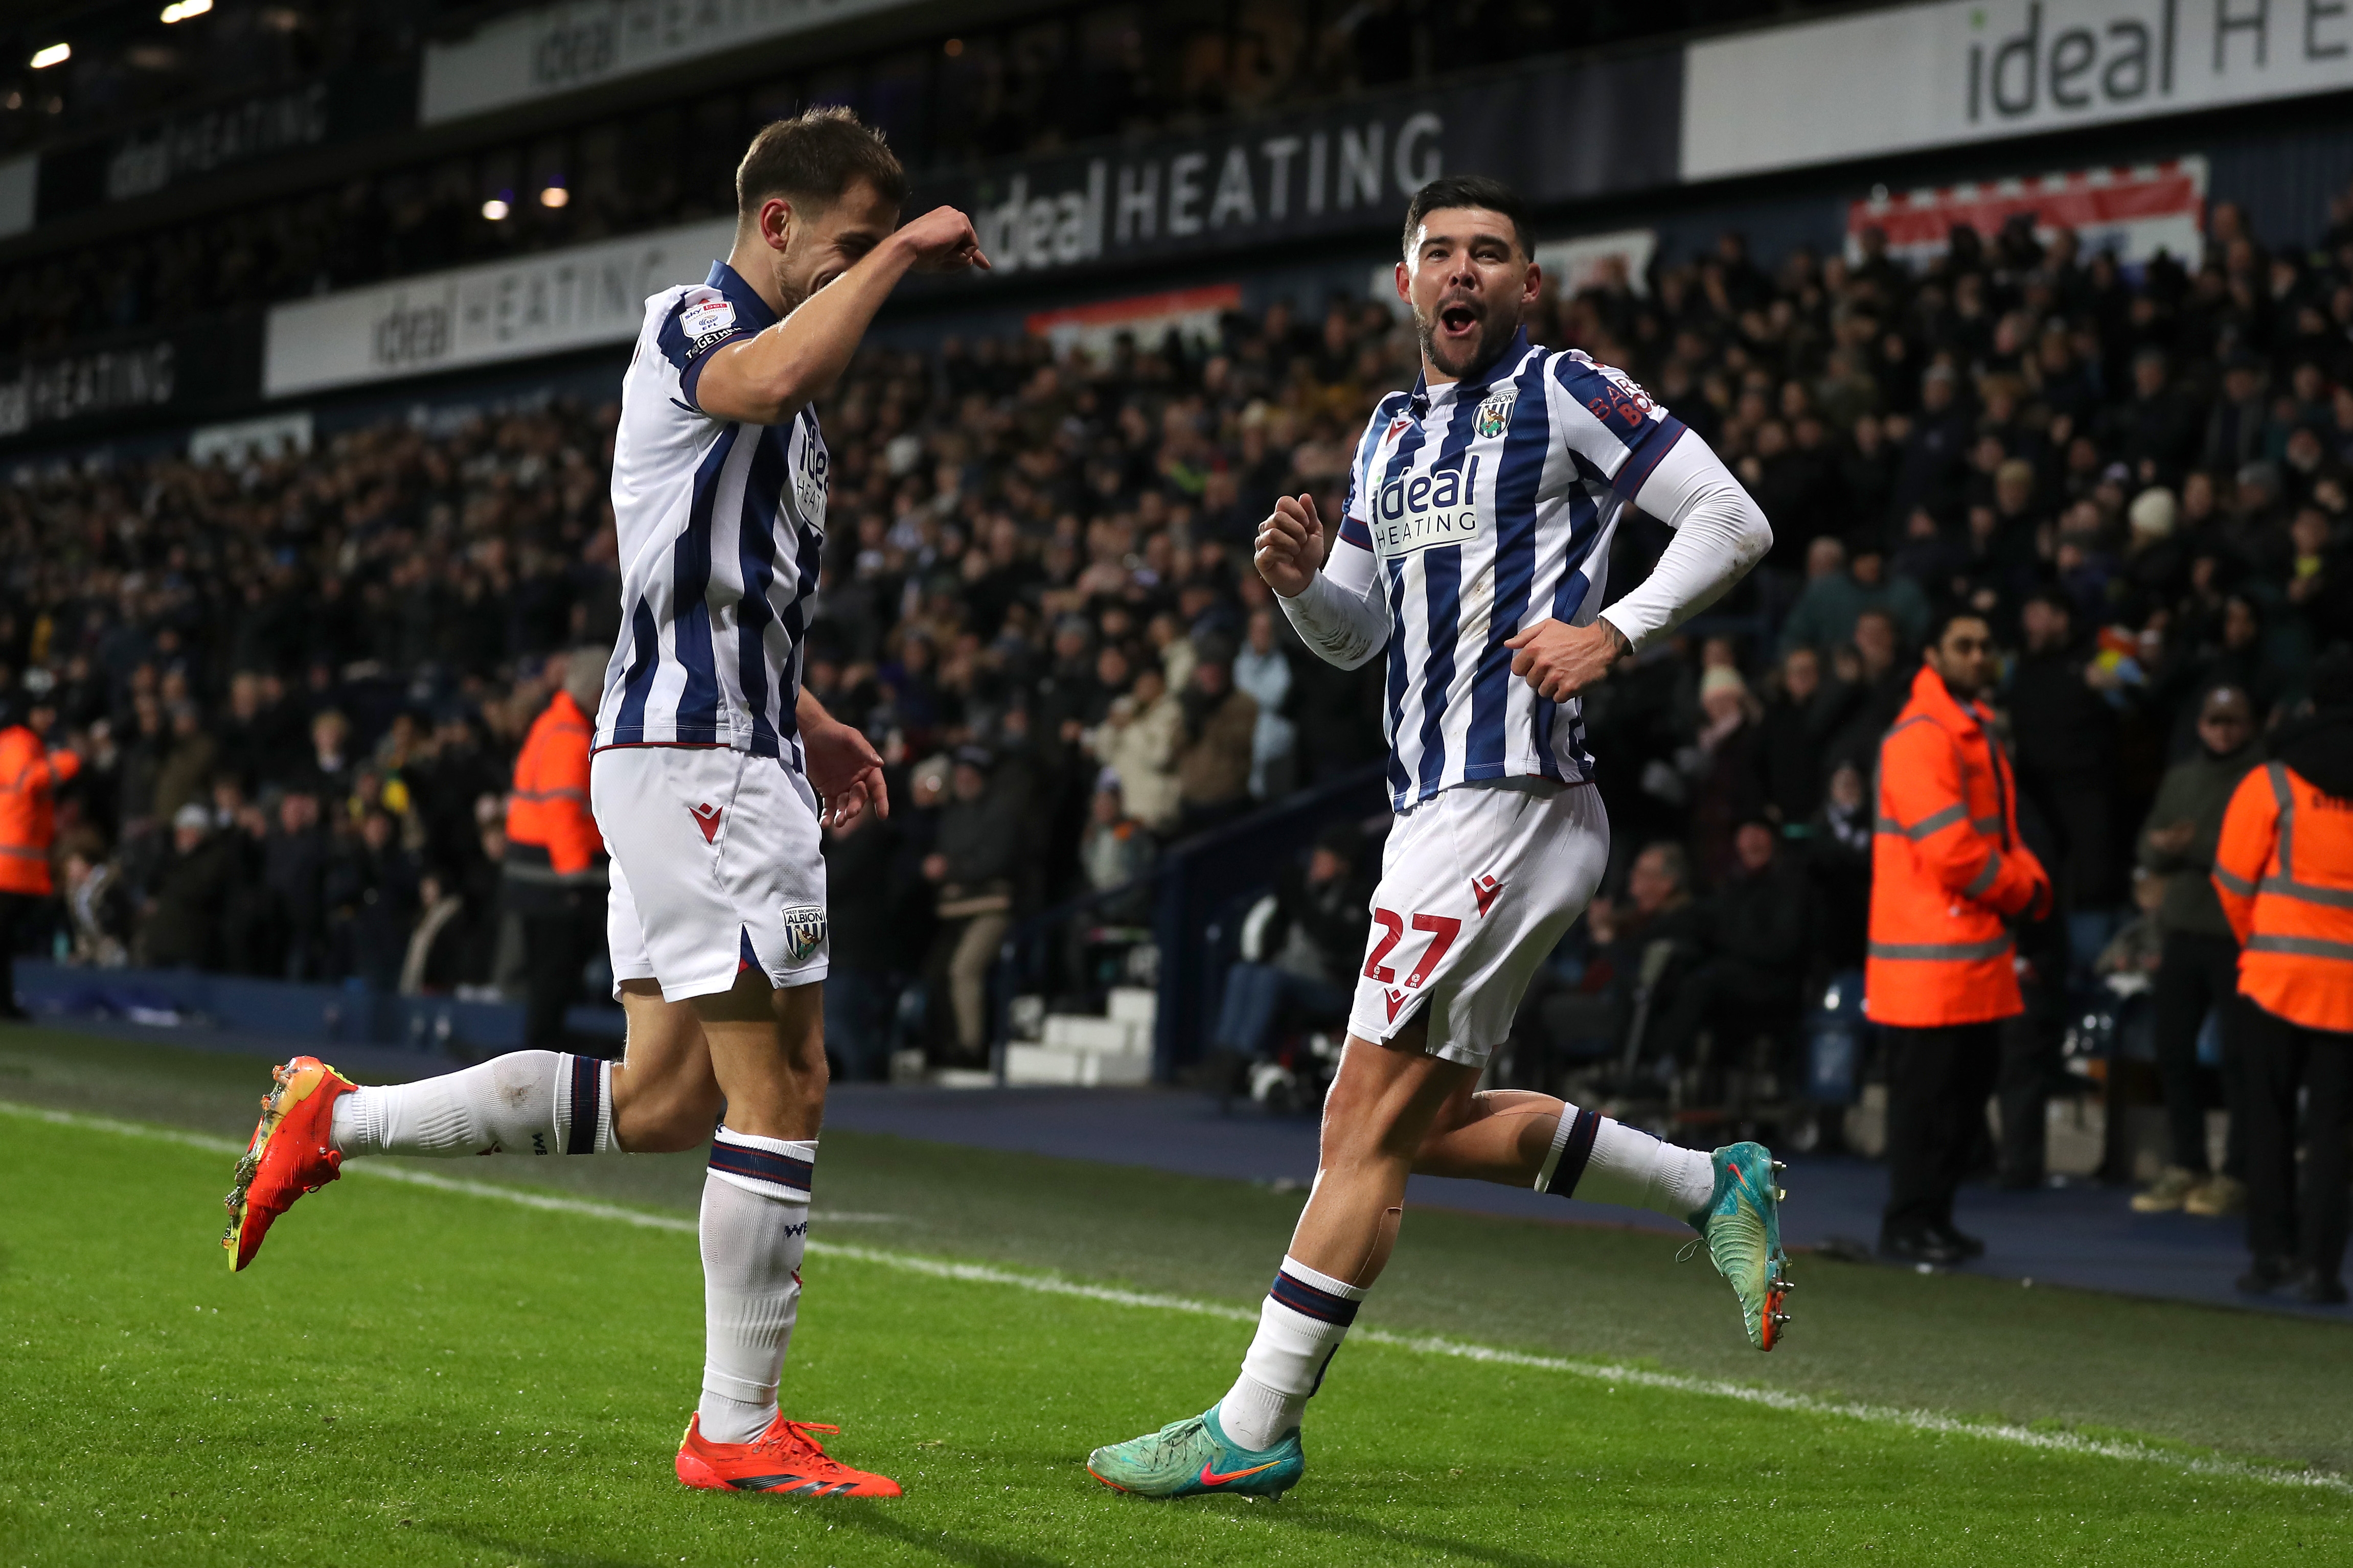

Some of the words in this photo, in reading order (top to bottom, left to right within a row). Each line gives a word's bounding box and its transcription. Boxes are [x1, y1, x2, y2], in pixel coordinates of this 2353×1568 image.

[1967, 0, 2175, 124] ideal
[977, 159, 1106, 274] ideal
[1114, 111, 1443, 243] HEATING
[702, 322, 718, 331] EFL
[1481, 394, 1515, 405] ALBION
[1371, 455, 1480, 525] ideal
[1376, 512, 1476, 549] HEATING
[787, 912, 823, 925] ALBION
[1363, 907, 1462, 989] 27
